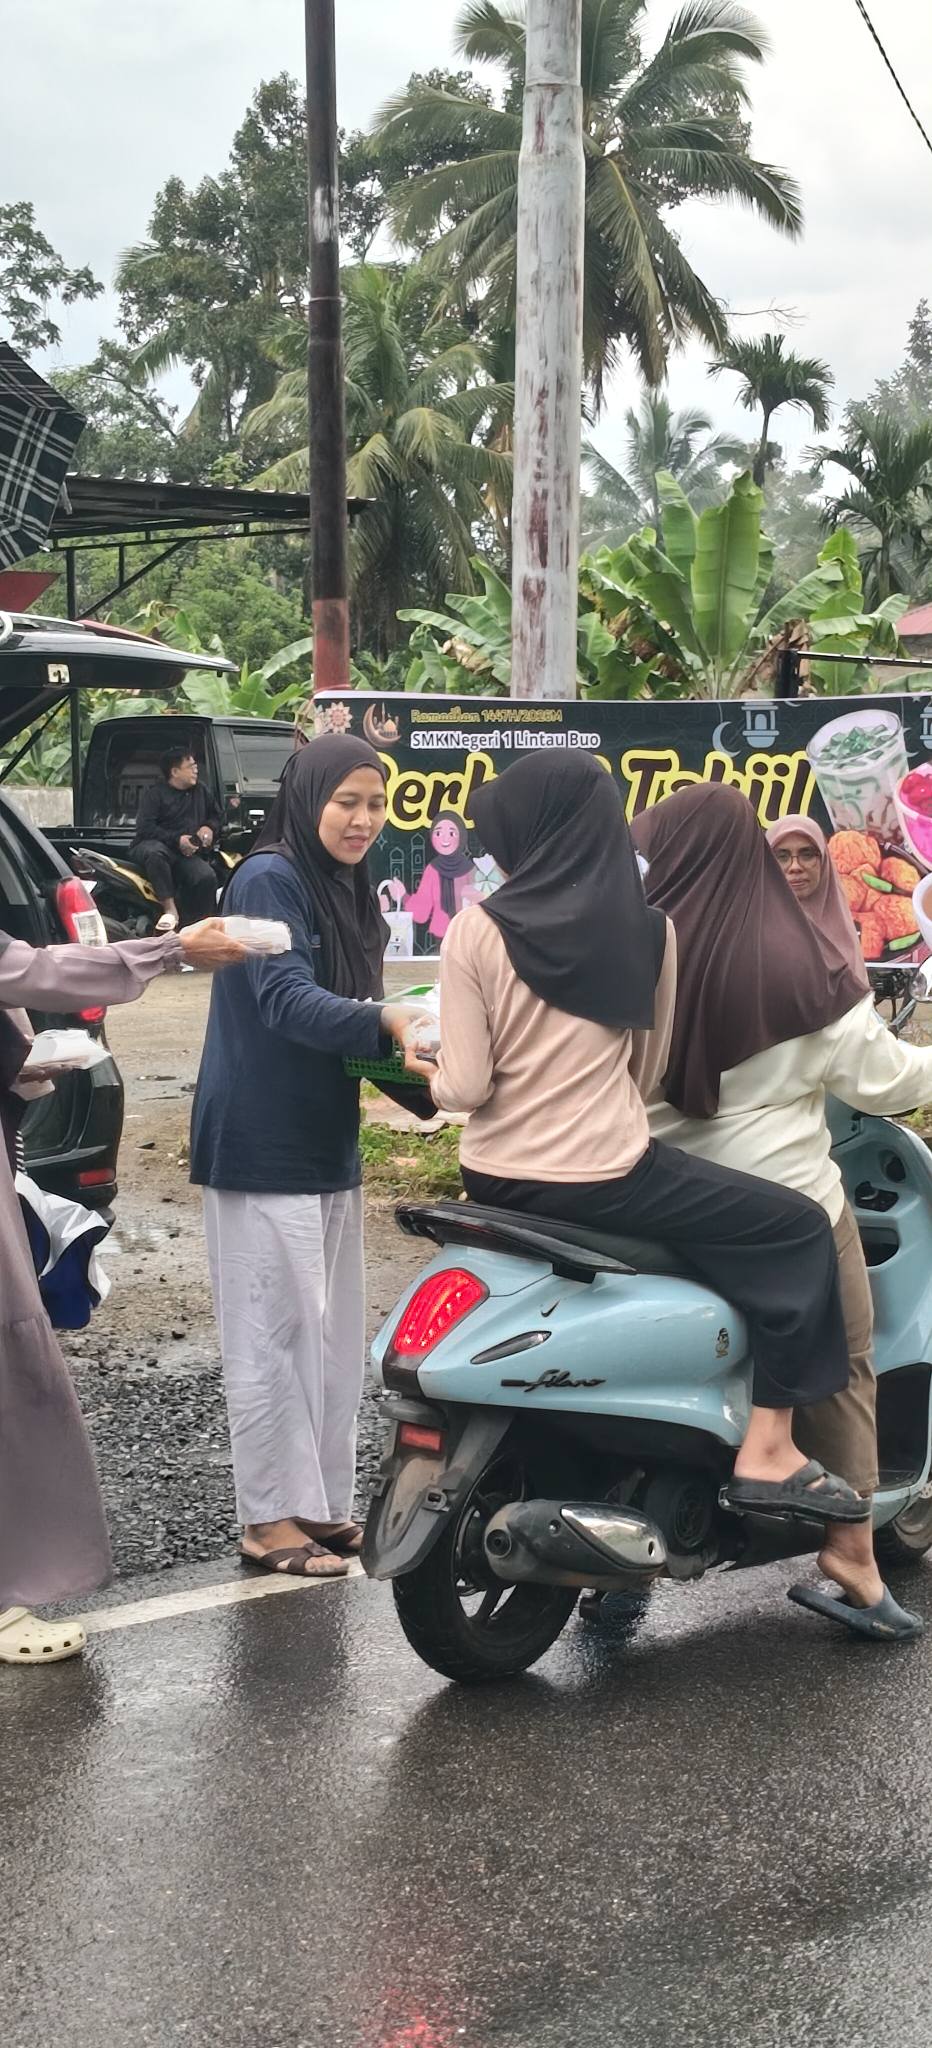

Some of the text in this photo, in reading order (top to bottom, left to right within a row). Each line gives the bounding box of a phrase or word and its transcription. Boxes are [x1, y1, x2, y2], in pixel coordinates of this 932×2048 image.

[411, 706, 480, 723] Ramadhan
[411, 730, 601, 752] SMK Negeri 1 Lintau Buo
